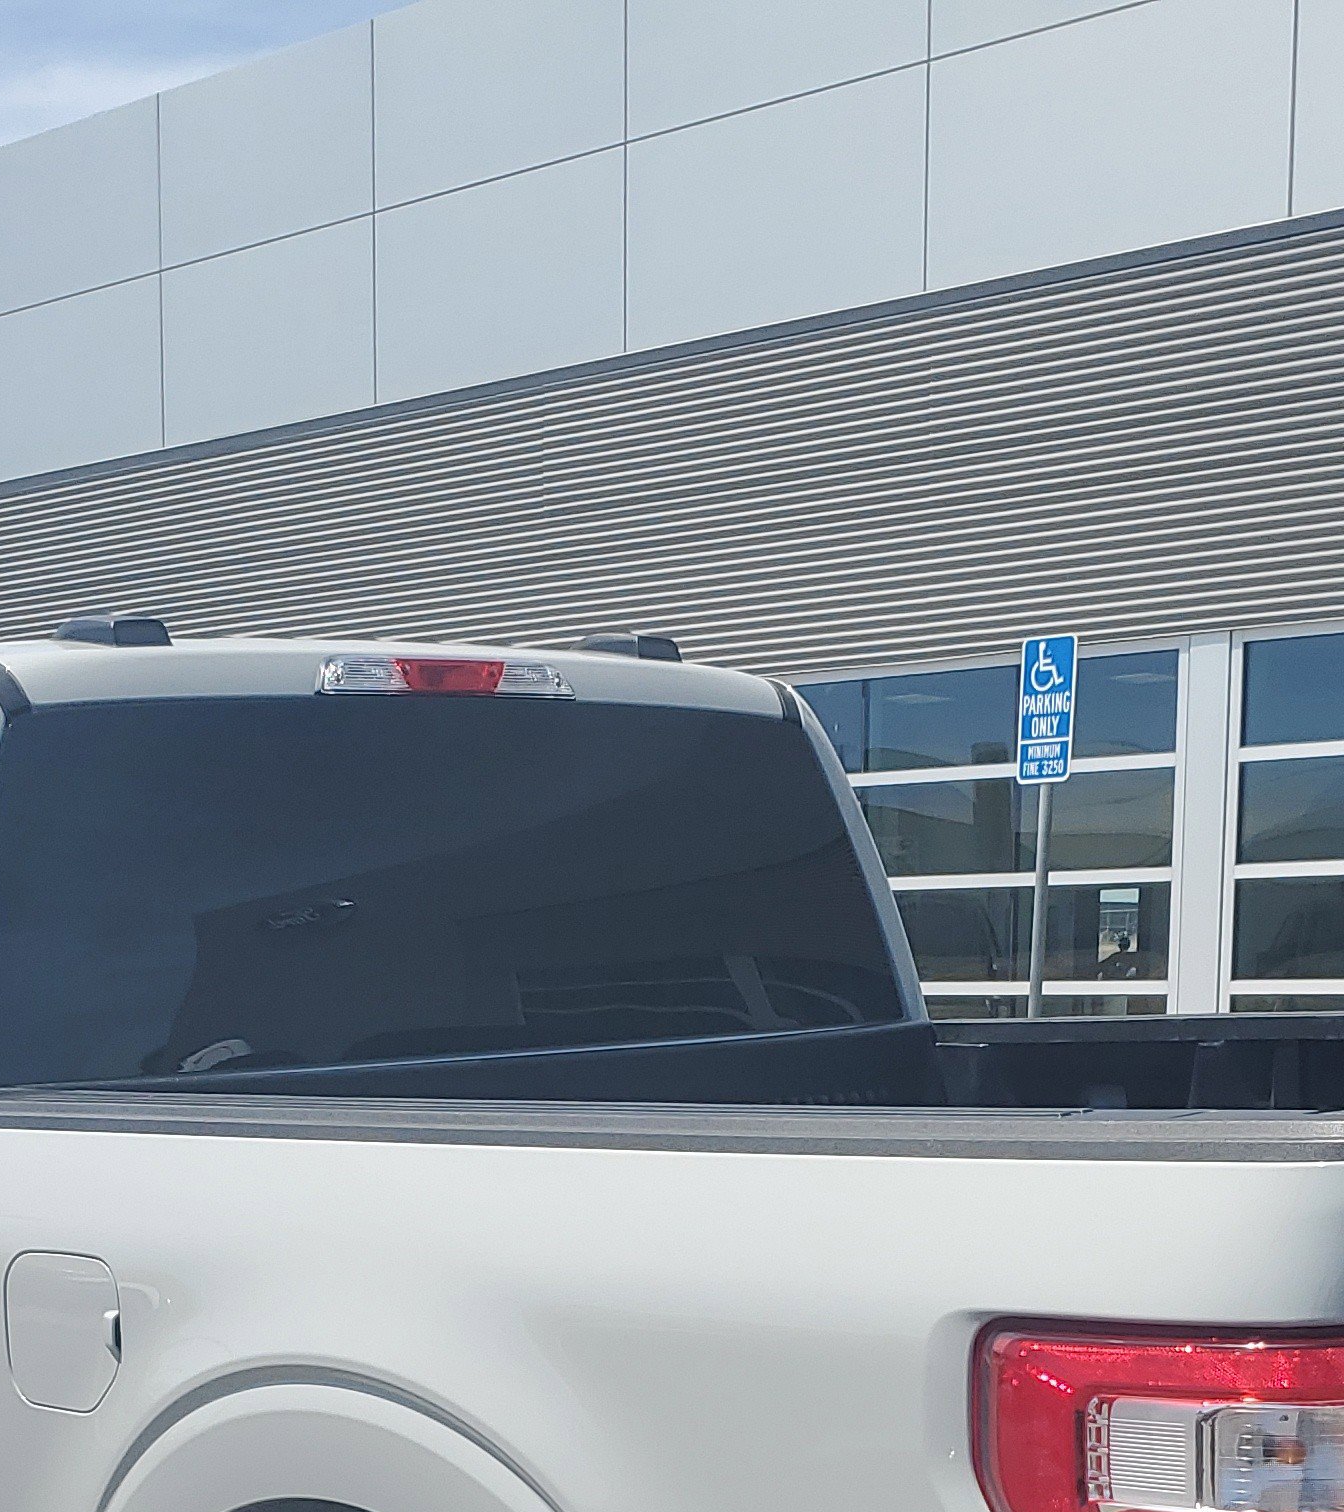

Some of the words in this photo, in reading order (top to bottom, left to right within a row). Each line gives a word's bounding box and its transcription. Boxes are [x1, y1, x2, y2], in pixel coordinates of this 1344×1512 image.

[1022, 691, 1070, 716] PARKING
[1031, 715, 1060, 738] ONLY
[1027, 743, 1060, 761] MINIMUM
[1022, 761, 1040, 777] FINE
